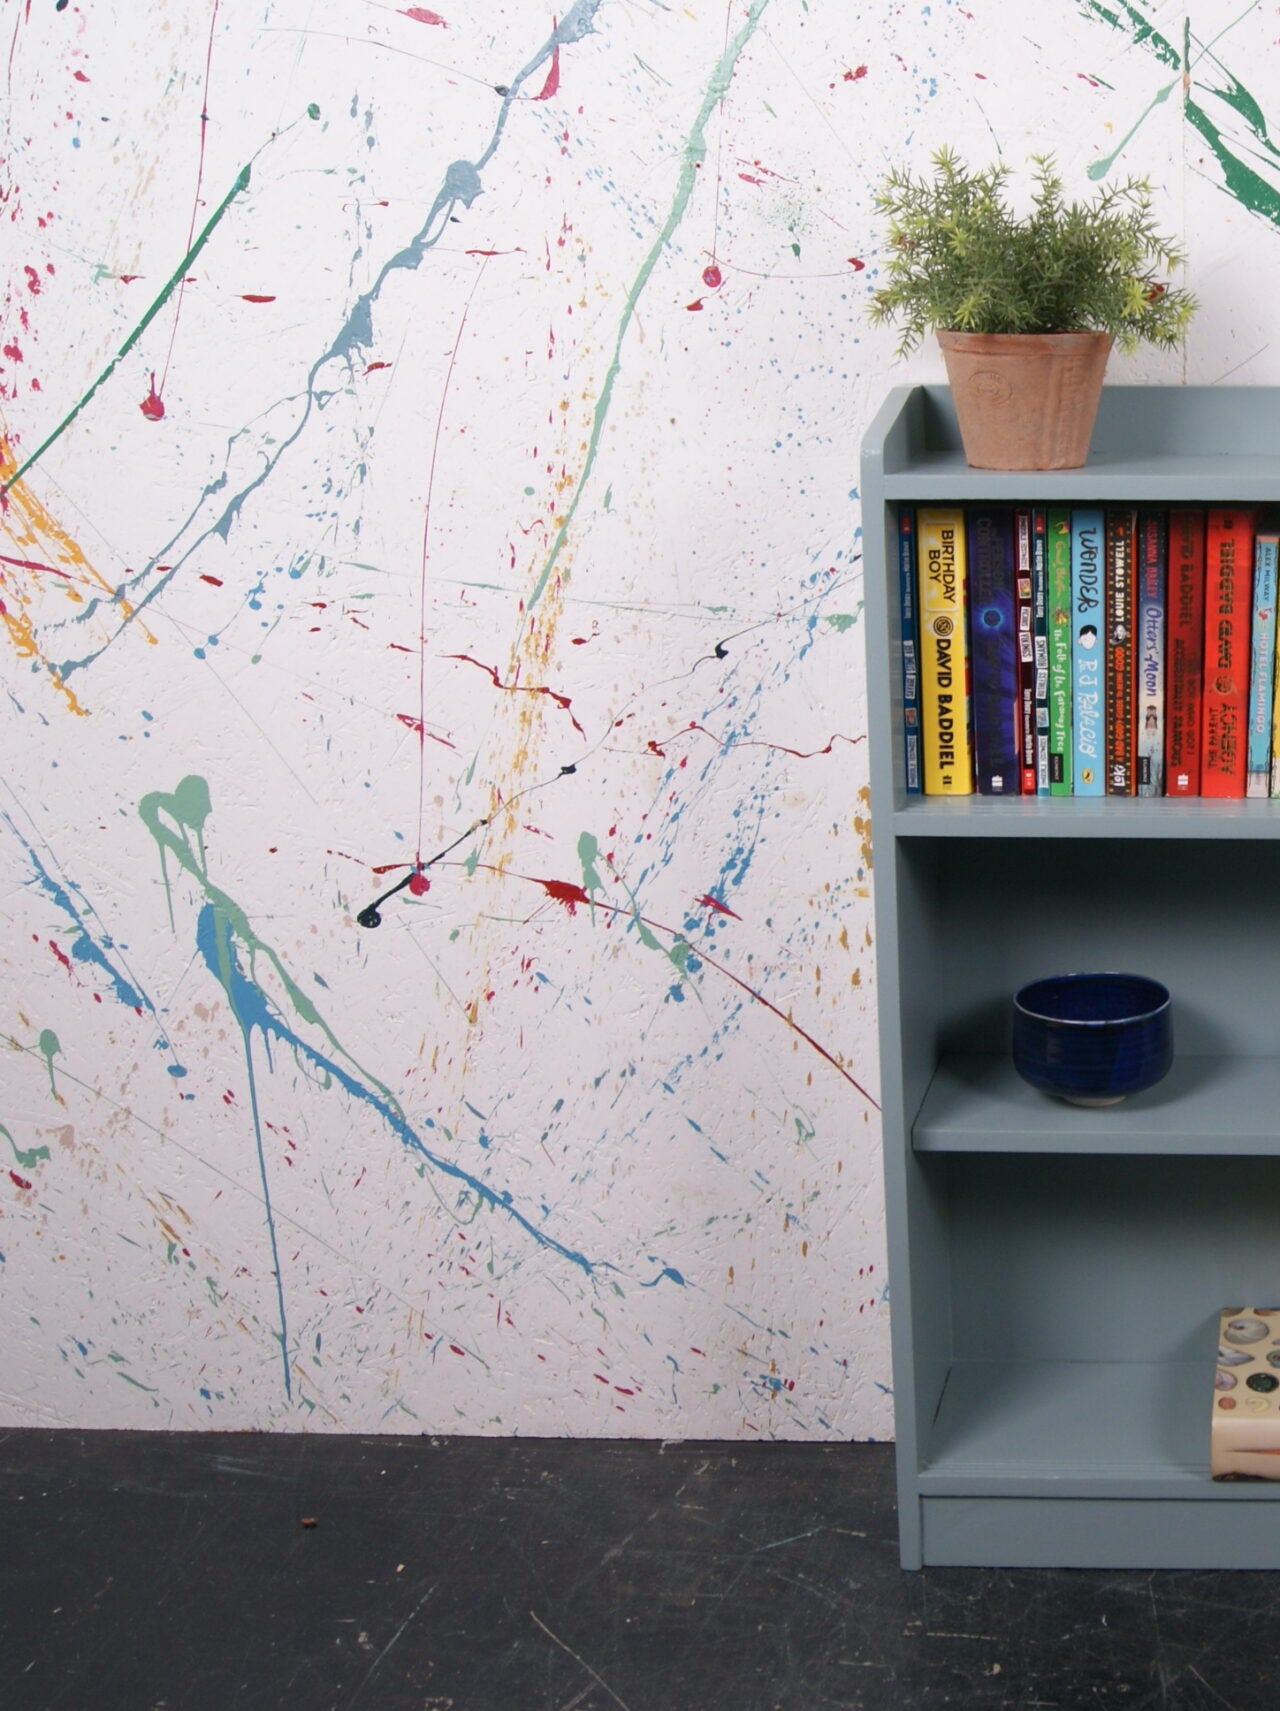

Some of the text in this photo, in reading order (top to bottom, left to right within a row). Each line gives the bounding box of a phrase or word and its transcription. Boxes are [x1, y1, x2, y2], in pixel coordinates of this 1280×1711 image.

[928, 548, 942, 582] BOY
[941, 529, 956, 603] BIRTHDAY
[1077, 527, 1099, 613] WONDER
[1115, 541, 1125, 622] LOUIE STOWELL
[1145, 520, 1158, 599] SUSANNA BAILEY
[1263, 546, 1272, 602] ALEX MILWAY
[1179, 563, 1193, 629] BADDIEL
[1218, 539, 1235, 669] DAVID BADDIEL
[1053, 664, 1066, 674] of
[1115, 647, 1125, 671] GOOD
[1143, 655, 1159, 697] Moon
[1255, 632, 1268, 734] HOTEL FLAMINGO
[935, 638, 954, 768] DAVID BADDIEL
[1053, 690, 1066, 728] Faraway
[1056, 730, 1066, 752] Tree
[1115, 741, 1125, 756] BAD
[1171, 715, 1183, 766] FAMOUS
[1208, 707, 1218, 769] THE PARENT
[1219, 702, 1237, 775] AGENCY
